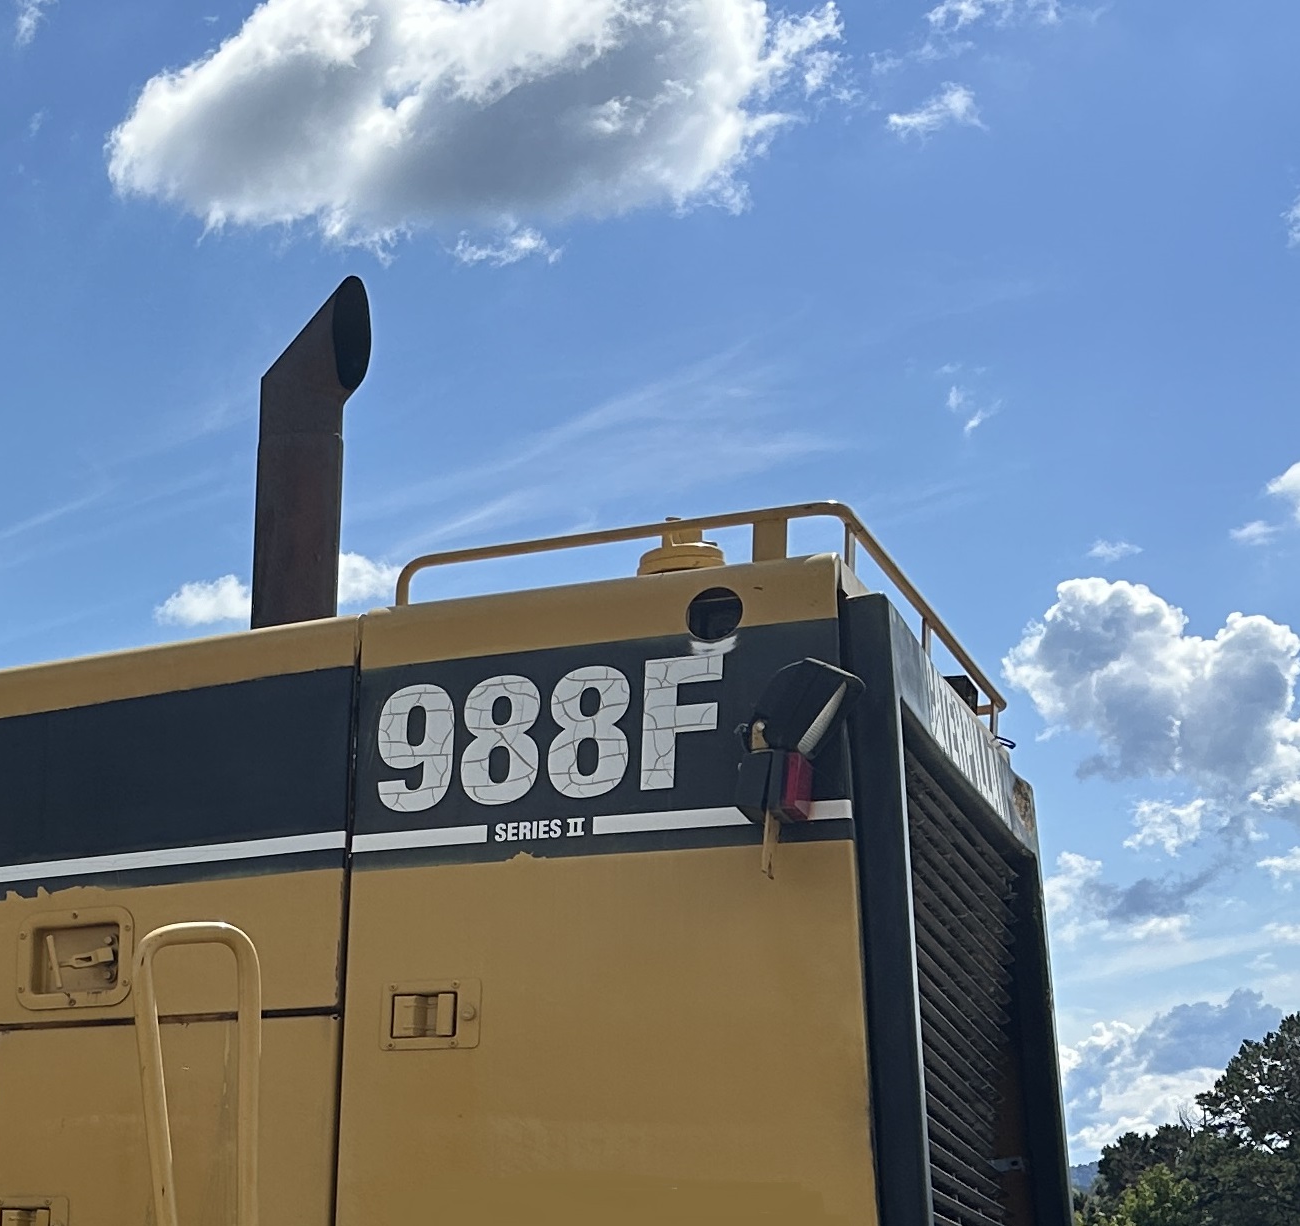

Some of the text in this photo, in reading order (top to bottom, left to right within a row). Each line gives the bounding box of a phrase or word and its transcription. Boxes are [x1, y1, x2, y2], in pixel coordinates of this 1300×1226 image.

[377, 654, 724, 812] 988F
[494, 817, 586, 842] SERIES II
